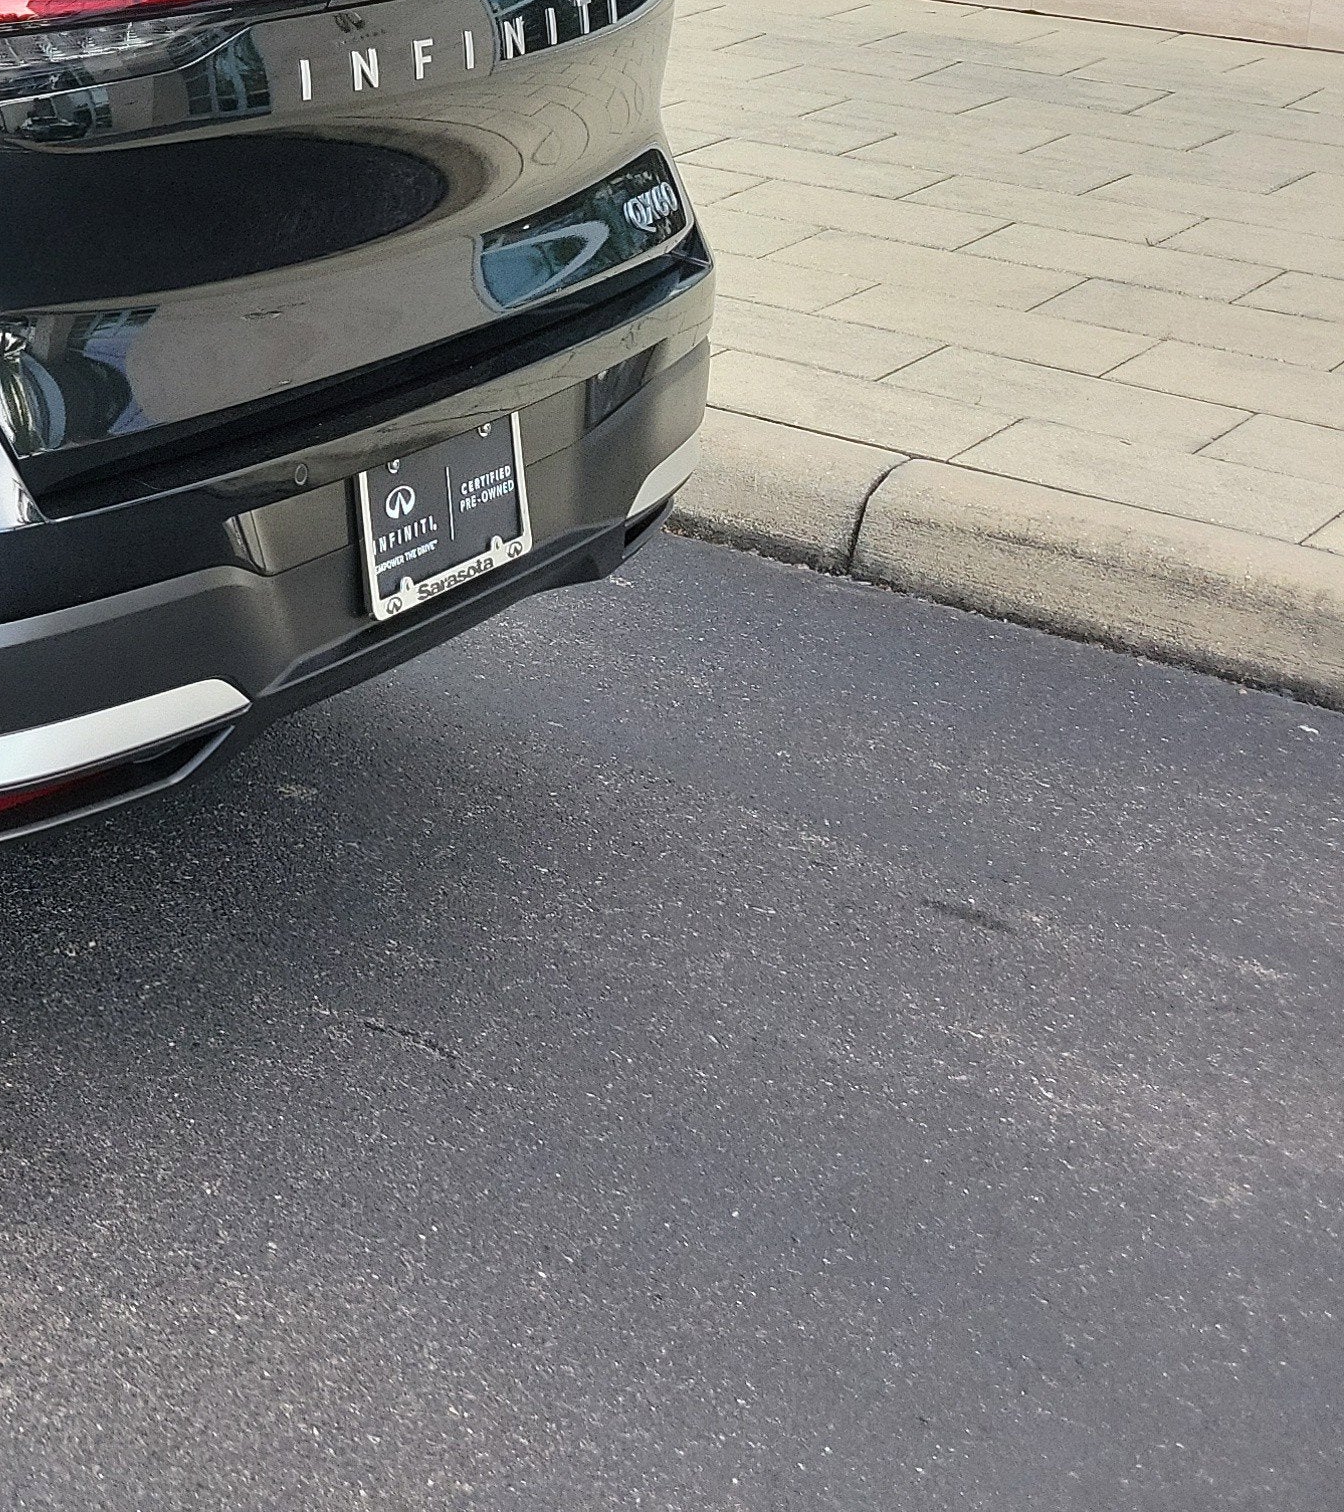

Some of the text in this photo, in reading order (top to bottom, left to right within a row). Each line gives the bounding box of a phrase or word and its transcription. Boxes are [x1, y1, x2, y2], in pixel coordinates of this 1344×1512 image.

[623, 181, 678, 233] QX60
[460, 464, 512, 495] CERTIFIED
[460, 479, 515, 513] PRE-OWNED
[373, 515, 435, 556] INFINITI
[417, 556, 495, 602] Sarasota
